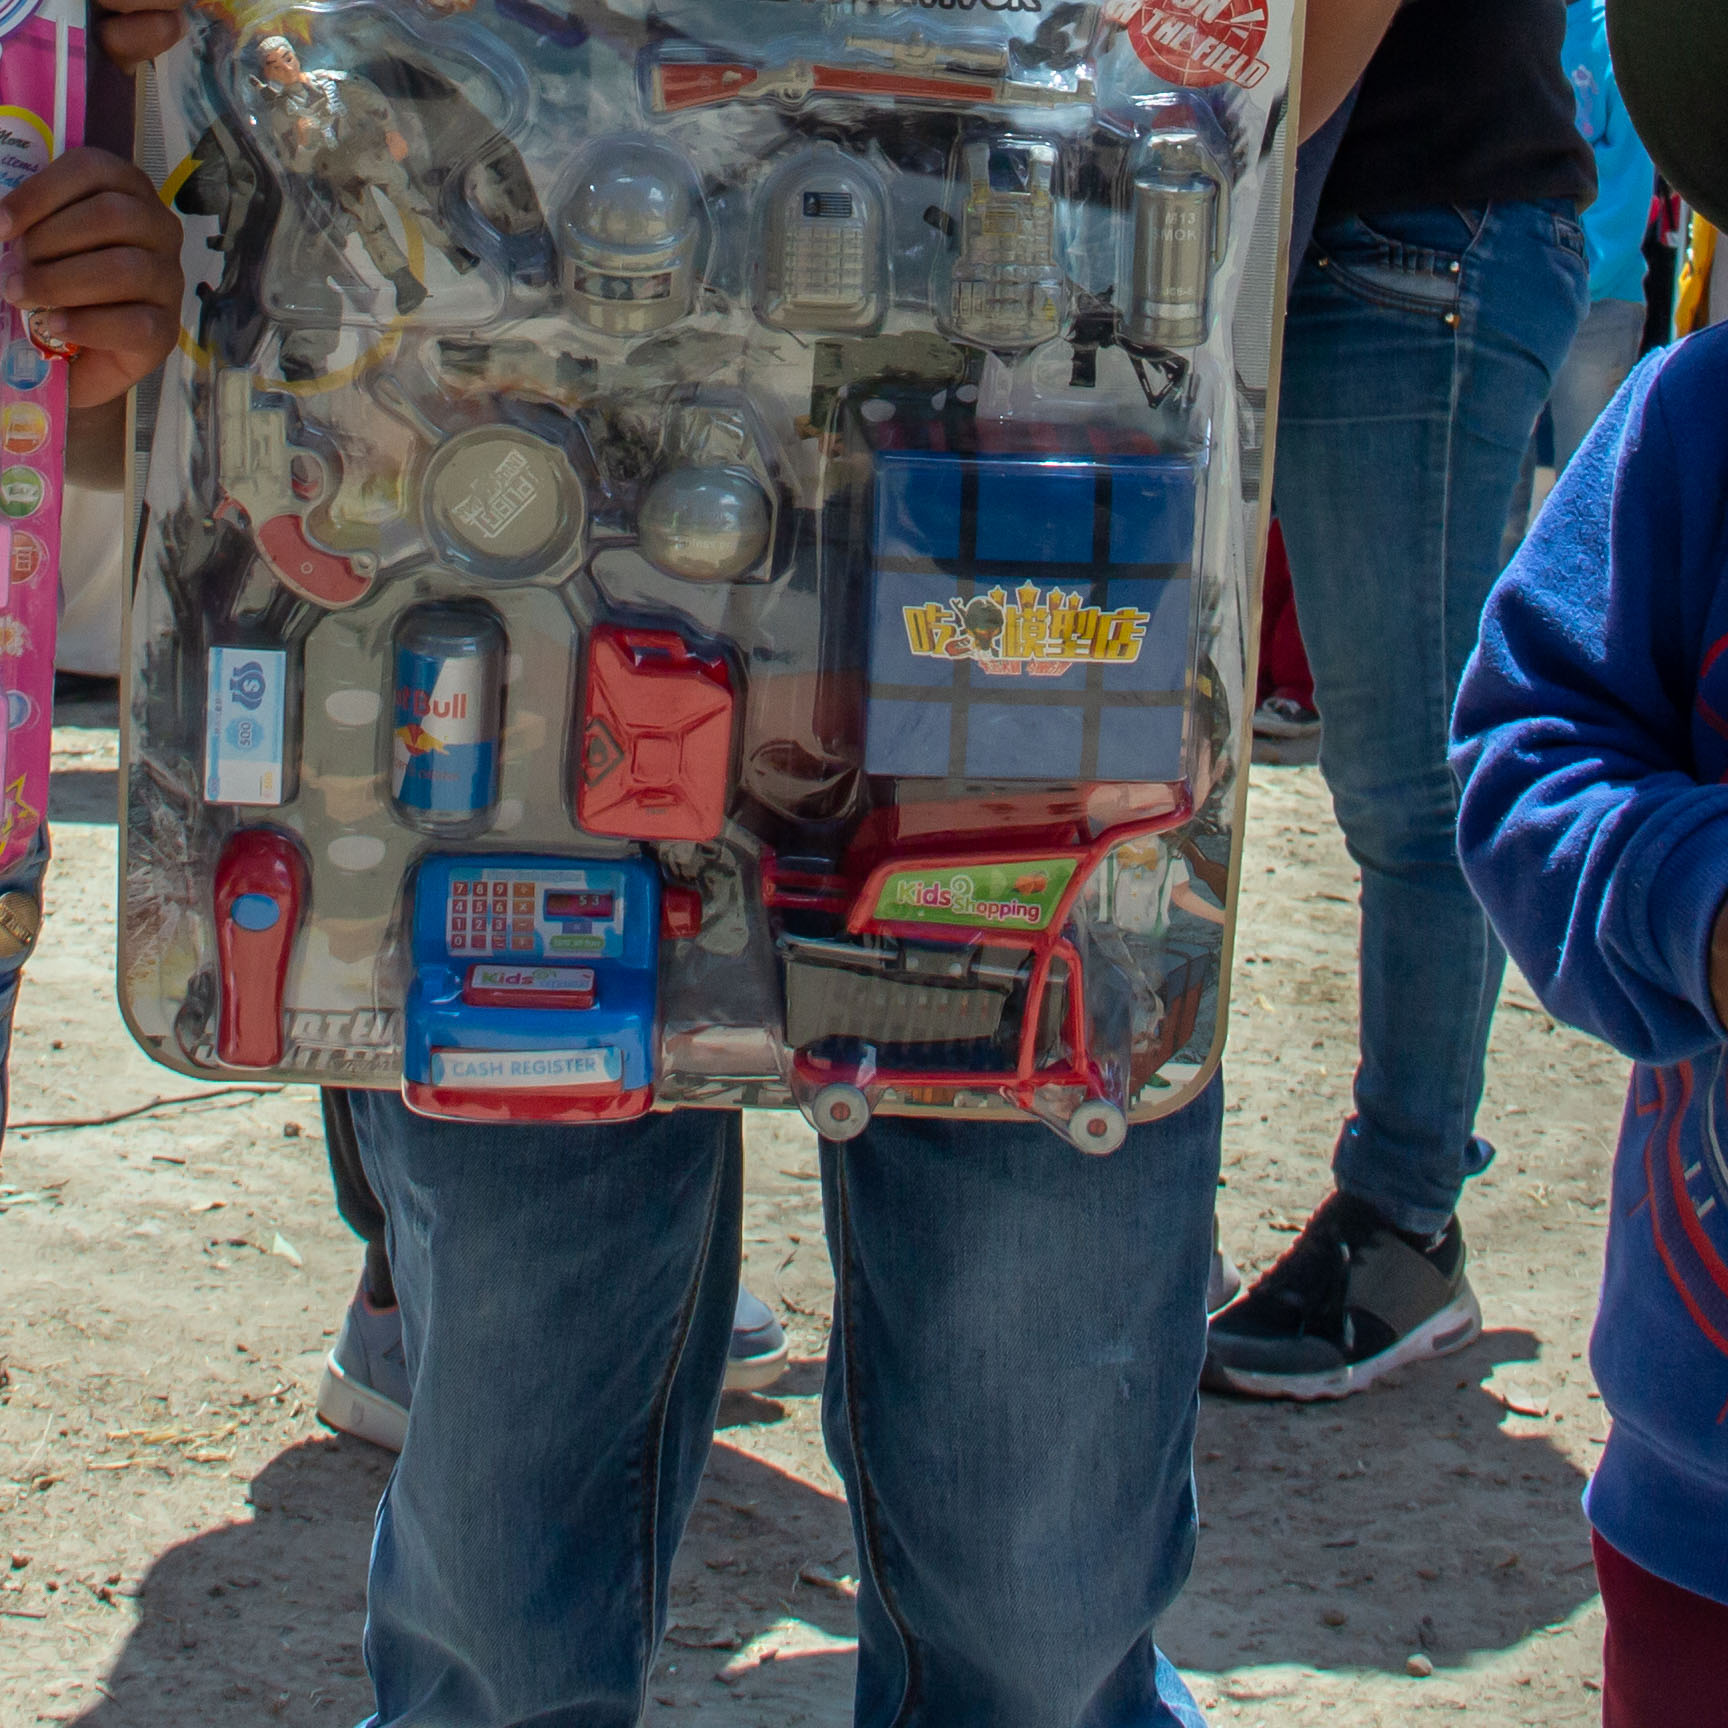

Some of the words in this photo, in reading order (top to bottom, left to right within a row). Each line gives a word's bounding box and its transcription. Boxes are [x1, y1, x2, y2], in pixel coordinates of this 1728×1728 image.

[1140, 7, 1198, 51] THE
[1190, 35, 1269, 89] FIELD
[1, 154, 40, 173] items
[413, 690, 468, 720] Bull
[238, 721, 252, 747] 500
[455, 883, 465, 895] 7
[475, 883, 484, 895] 8
[495, 883, 504, 895] 9
[455, 901, 463, 913] 4
[475, 901, 484, 913] 5
[495, 901, 503, 913] 6
[897, 880, 953, 907] Kids
[952, 894, 1041, 923] Shopping
[455, 919, 462, 930] 1
[475, 919, 483, 930] 2
[495, 919, 503, 931] 3
[454, 935, 463, 946] 0
[481, 970, 535, 986] Kids
[452, 1060, 504, 1078] CASH
[510, 1057, 597, 1076] REGISTER
